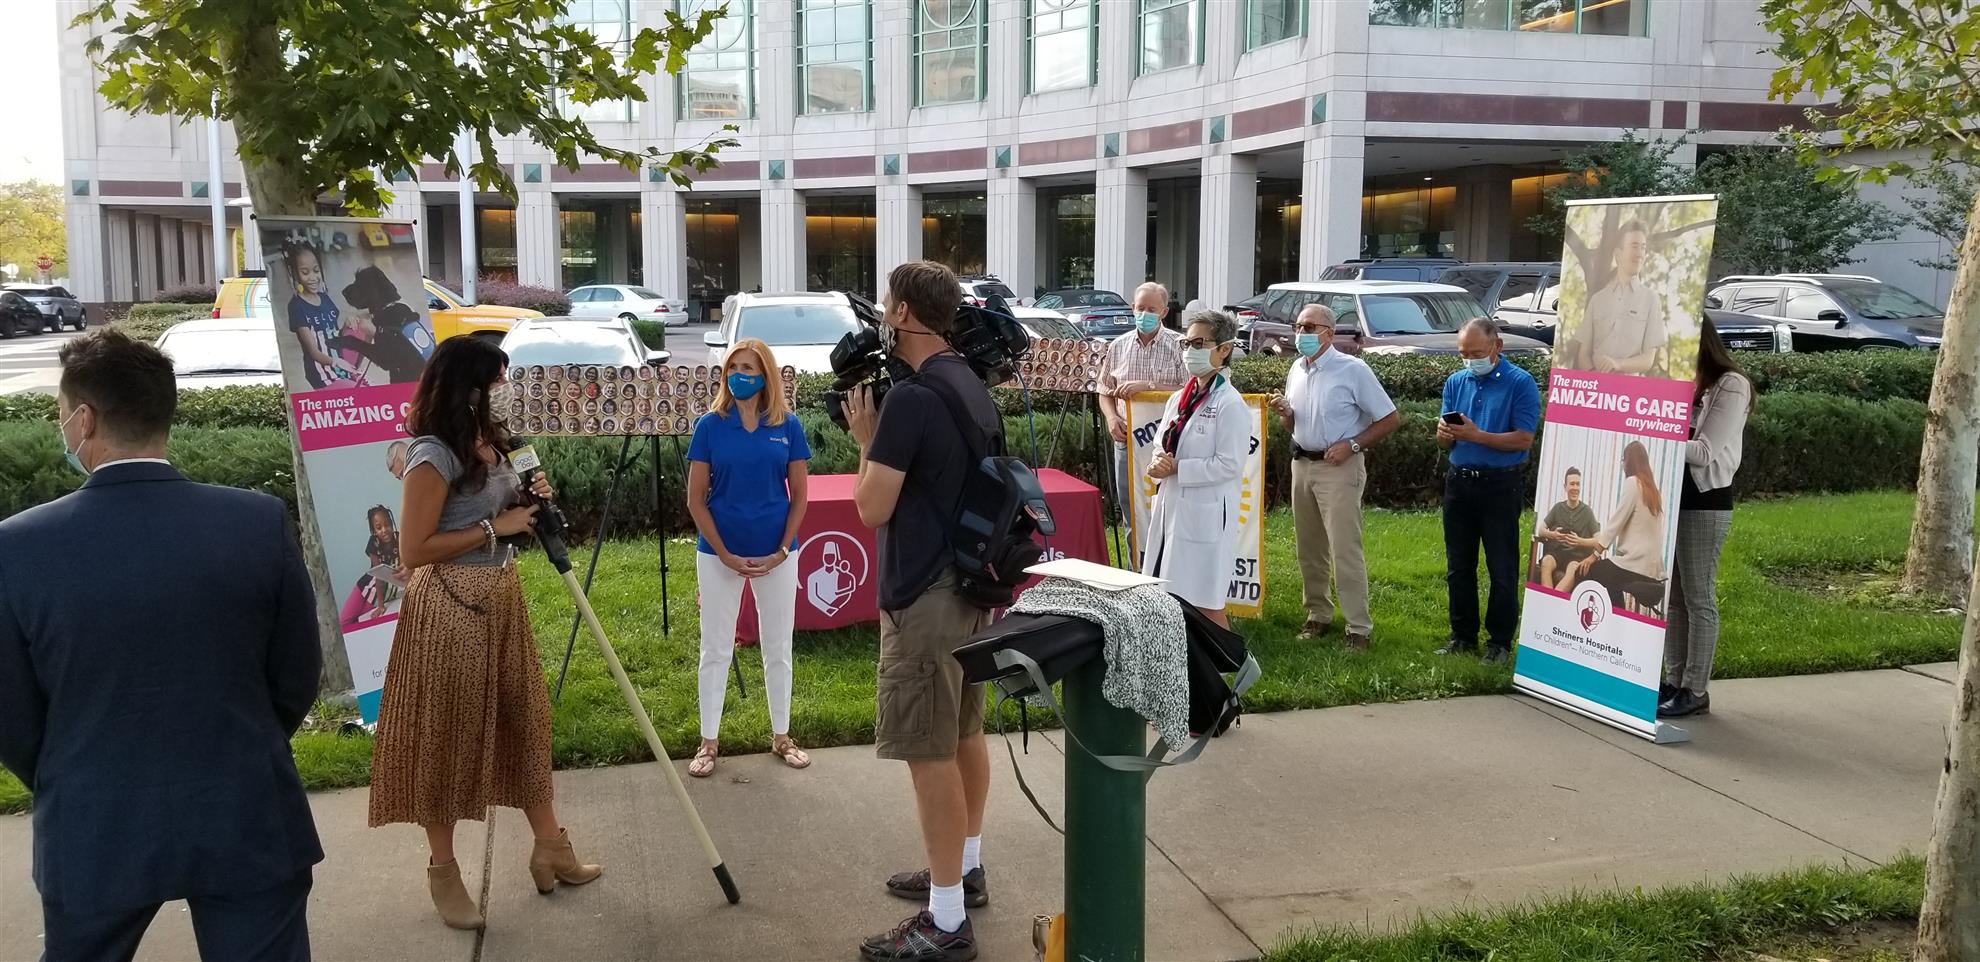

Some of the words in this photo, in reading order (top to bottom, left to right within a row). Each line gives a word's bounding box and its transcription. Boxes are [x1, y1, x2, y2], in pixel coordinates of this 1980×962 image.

[1553, 374, 1570, 387] The
[1572, 379, 1599, 390] most
[298, 398, 322, 411] The
[325, 396, 355, 409] most
[1549, 387, 1630, 413] AMAZING
[1635, 397, 1689, 420] CARE
[301, 404, 395, 430] AMAZING
[1625, 417, 1684, 434] anywhere.
[515, 455, 533, 466] Good
[1038, 547, 1065, 561] als
[1235, 557, 1257, 577] ST
[1227, 580, 1260, 601] NTO
[1552, 626, 1584, 644] Shriners
[1585, 637, 1623, 657] Hospitals
[1534, 630, 1543, 640] for
[1578, 645, 1608, 662] Northern
[1609, 655, 1642, 674] California
